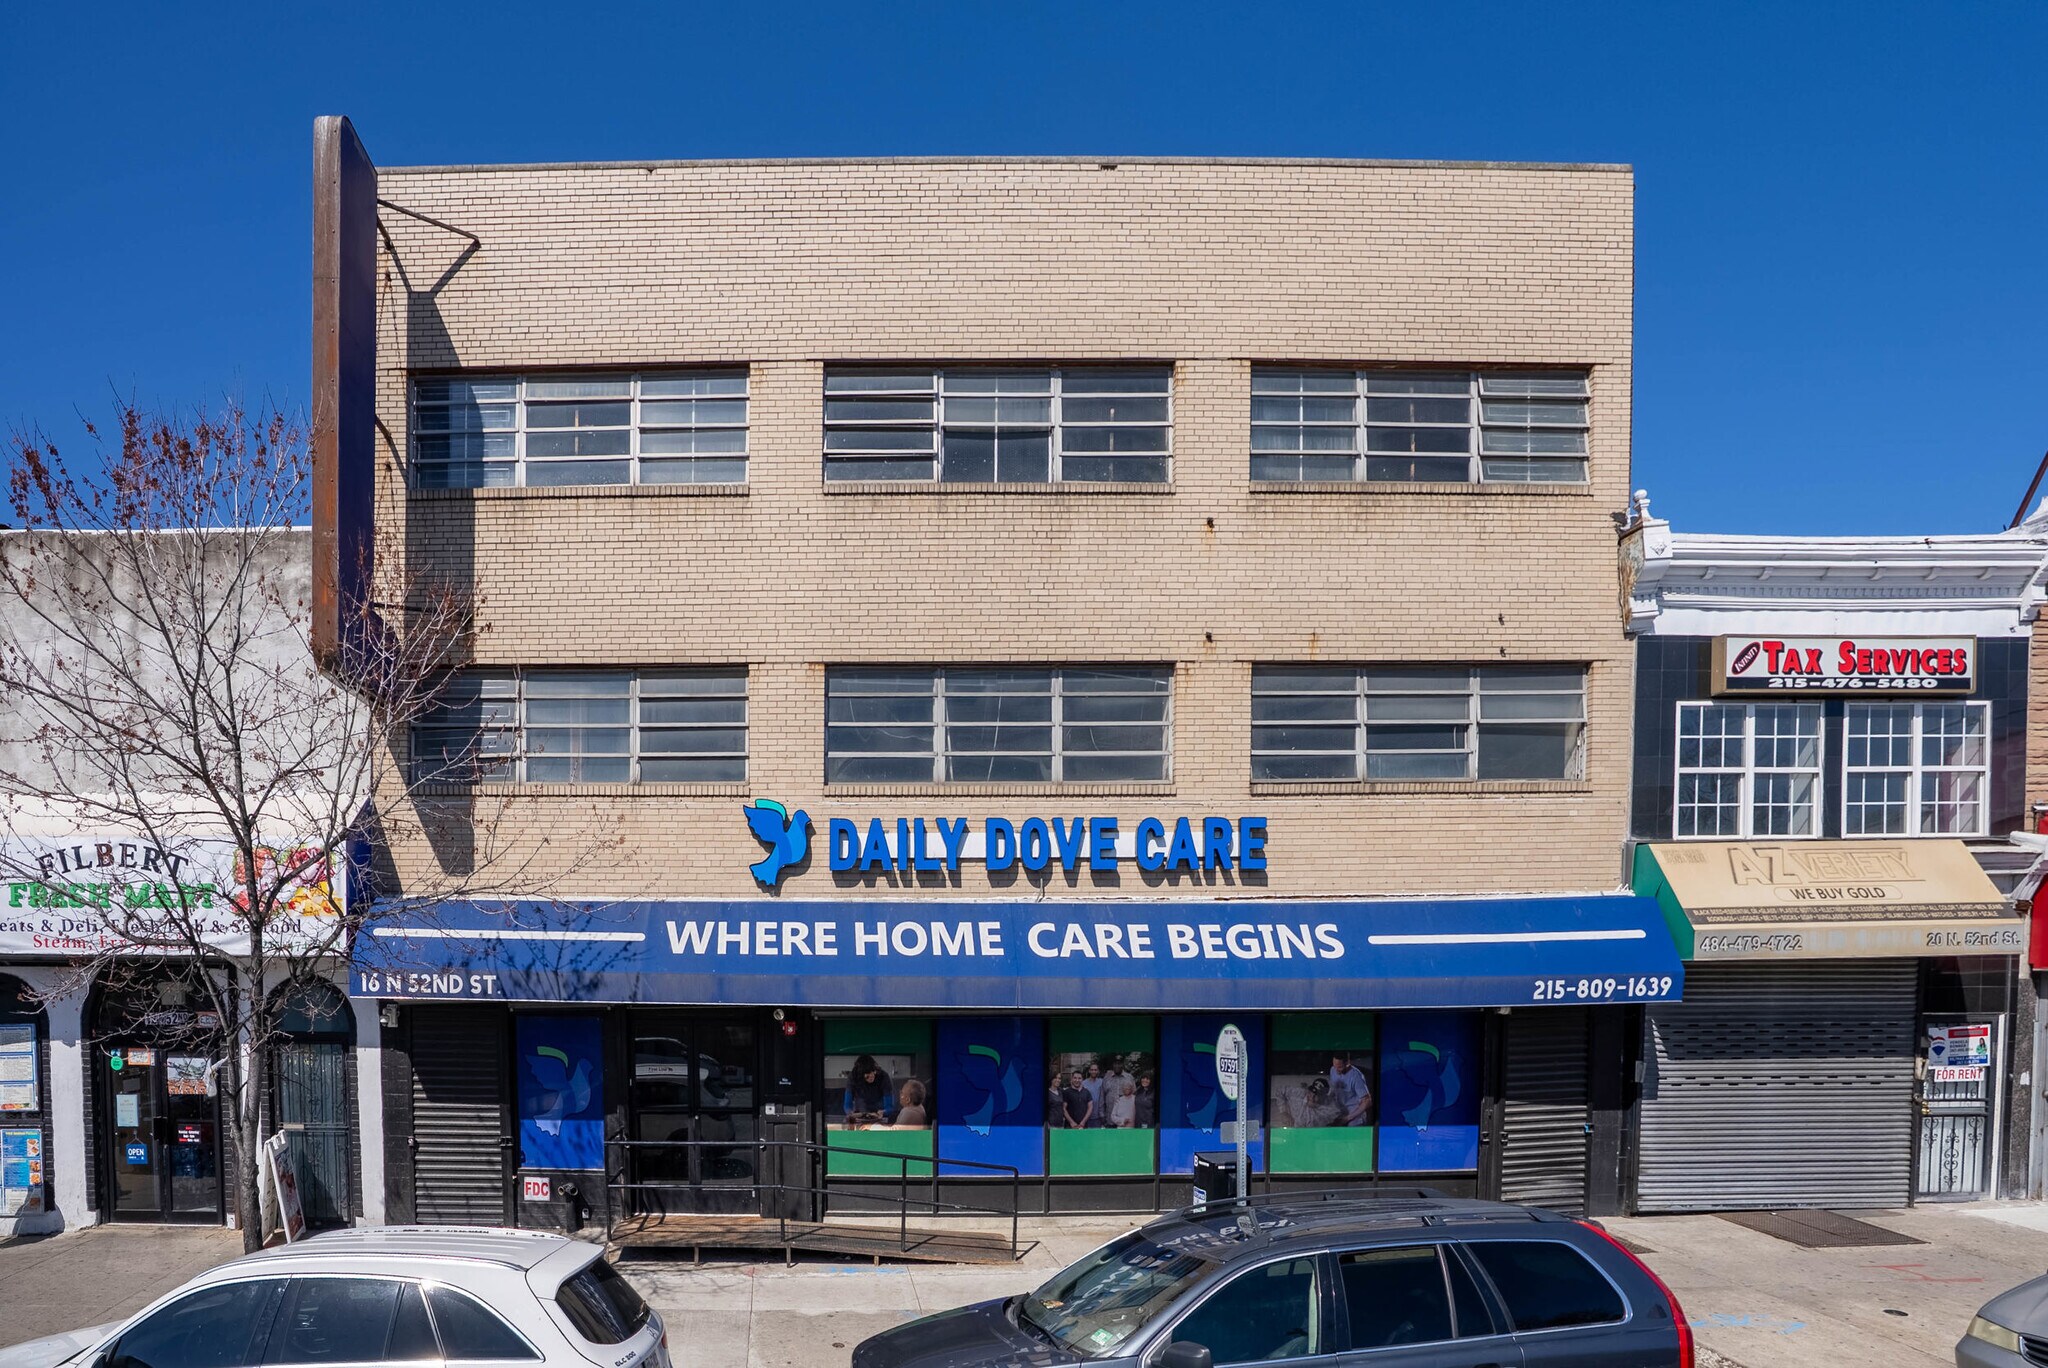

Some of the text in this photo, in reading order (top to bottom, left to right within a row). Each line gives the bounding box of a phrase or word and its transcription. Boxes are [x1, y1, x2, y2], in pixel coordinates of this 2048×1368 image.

[1768, 677, 1938, 689] 215-476-5480
[829, 817, 1268, 871] DAILY DOVE CARE
[36, 843, 189, 880] FILBERT
[1727, 847, 1802, 885] AZ
[9, 882, 217, 908] FRESH MART
[1789, 887, 1886, 900] WE BUY GOLD
[41, 919, 53, 932] &
[666, 920, 1345, 959] WHERE HOME CARE BEGINS
[1700, 931, 2021, 951] 484-479-4722 20 N. 52nd St.
[361, 972, 380, 993] 16
[386, 973, 401, 993] N
[408, 974, 463, 994] 52ND
[1533, 977, 1672, 1000] 215-809-1639
[1936, 1068, 1981, 1080] FOR RENT
[128, 1148, 144, 1156] OPEN
[525, 1181, 549, 1197] FDC
